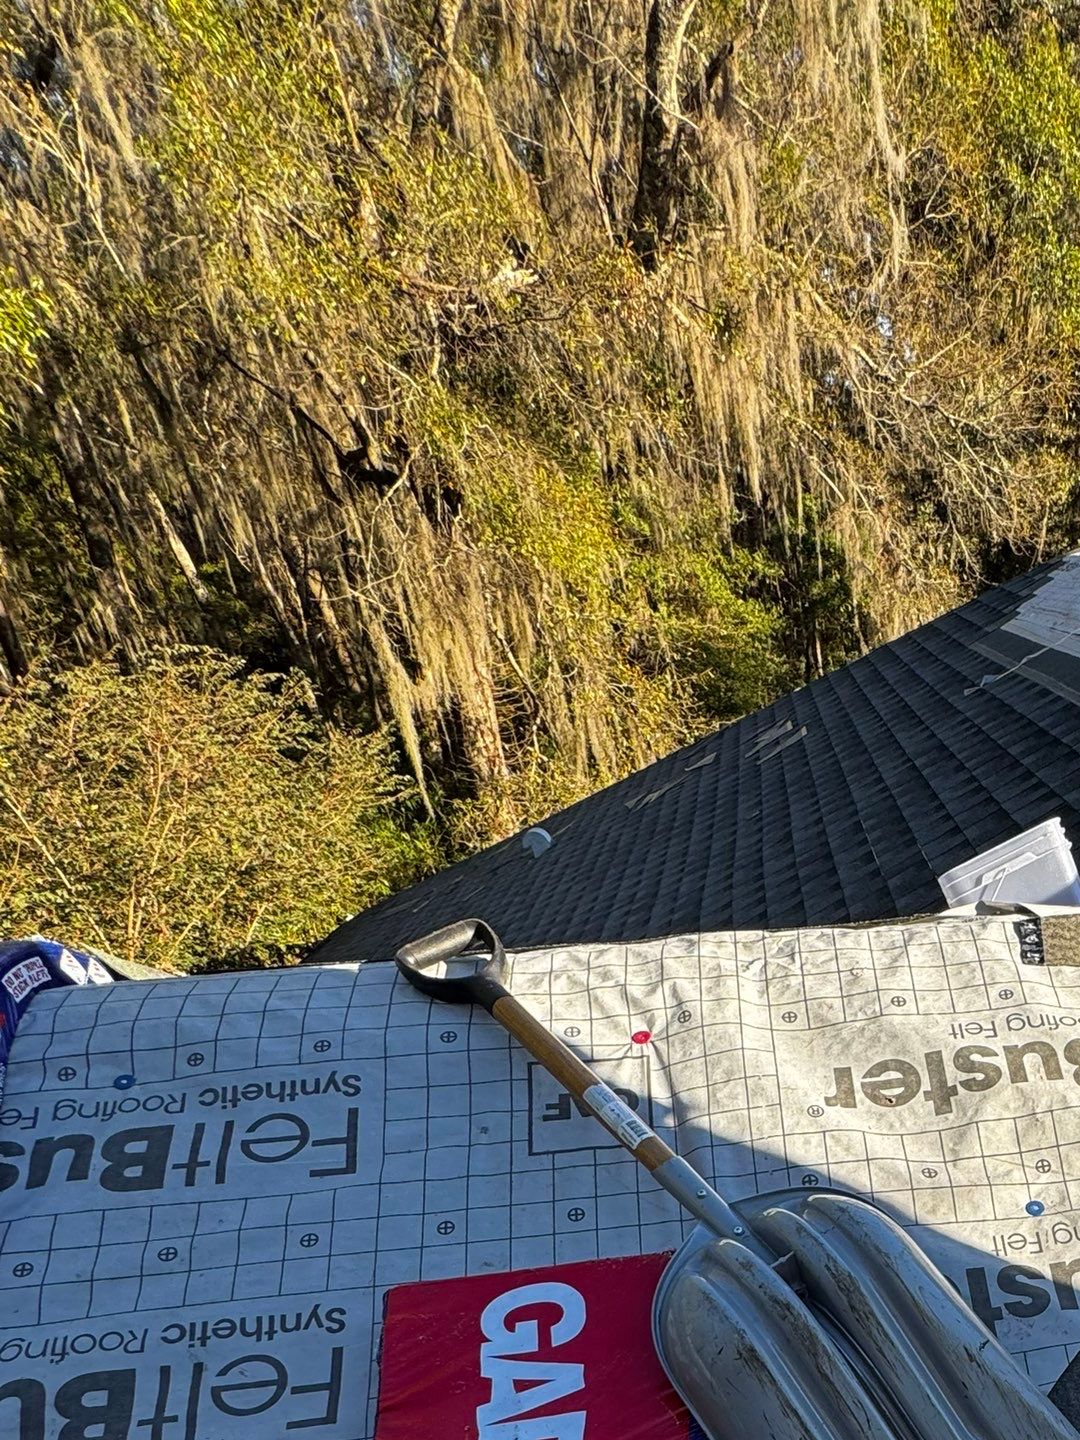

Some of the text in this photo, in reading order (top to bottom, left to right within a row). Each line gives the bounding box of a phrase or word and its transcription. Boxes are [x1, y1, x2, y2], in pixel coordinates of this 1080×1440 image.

[949, 1019, 997, 1040] Felt
[199, 1070, 362, 1110] Synthetic
[542, 1087, 640, 1122] GF
[52, 1092, 188, 1123] Roofing
[992, 1230, 1044, 1257] Felt
[0, 1302, 347, 1365] Synthetic Roofing
